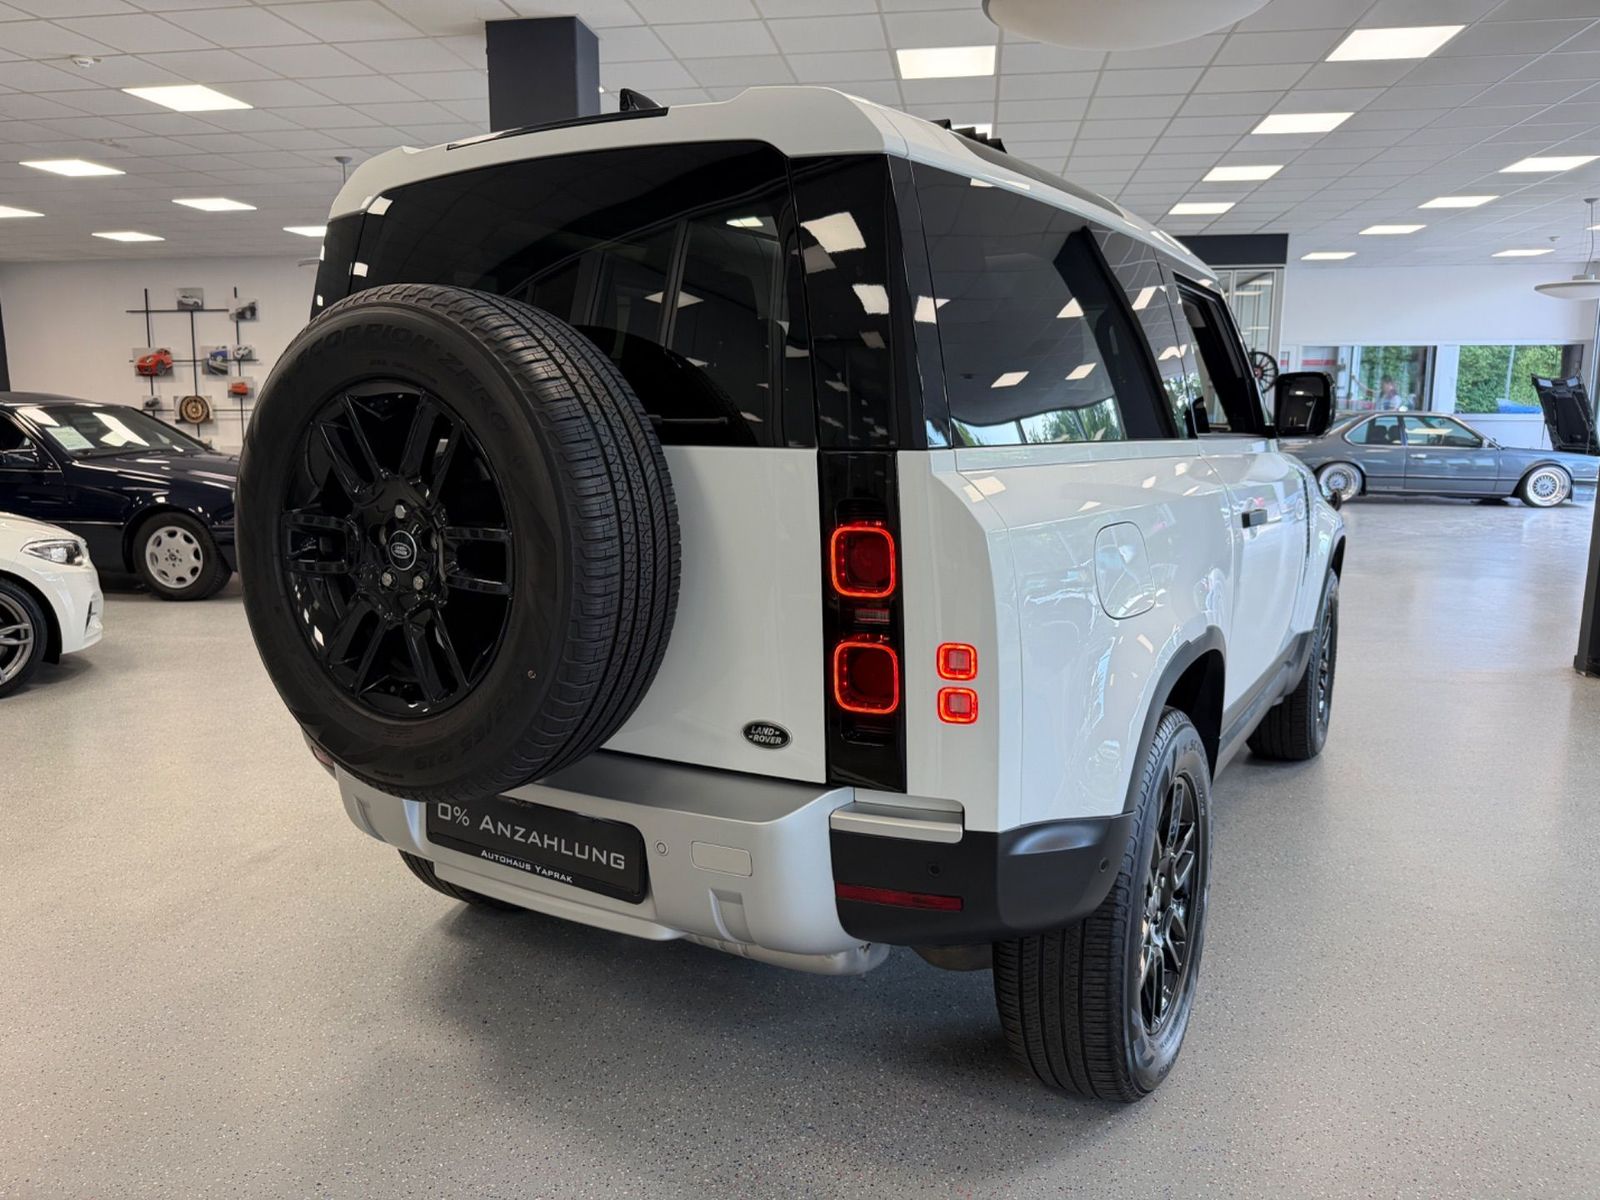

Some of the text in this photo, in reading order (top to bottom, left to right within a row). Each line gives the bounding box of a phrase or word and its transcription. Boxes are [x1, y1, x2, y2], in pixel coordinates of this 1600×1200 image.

[751, 725, 775, 736] LAND
[753, 734, 782, 745] ROVER
[437, 802, 625, 870] 0% ANZAHLUNG
[480, 849, 573, 884] AUTOHAUS YAPRAK
